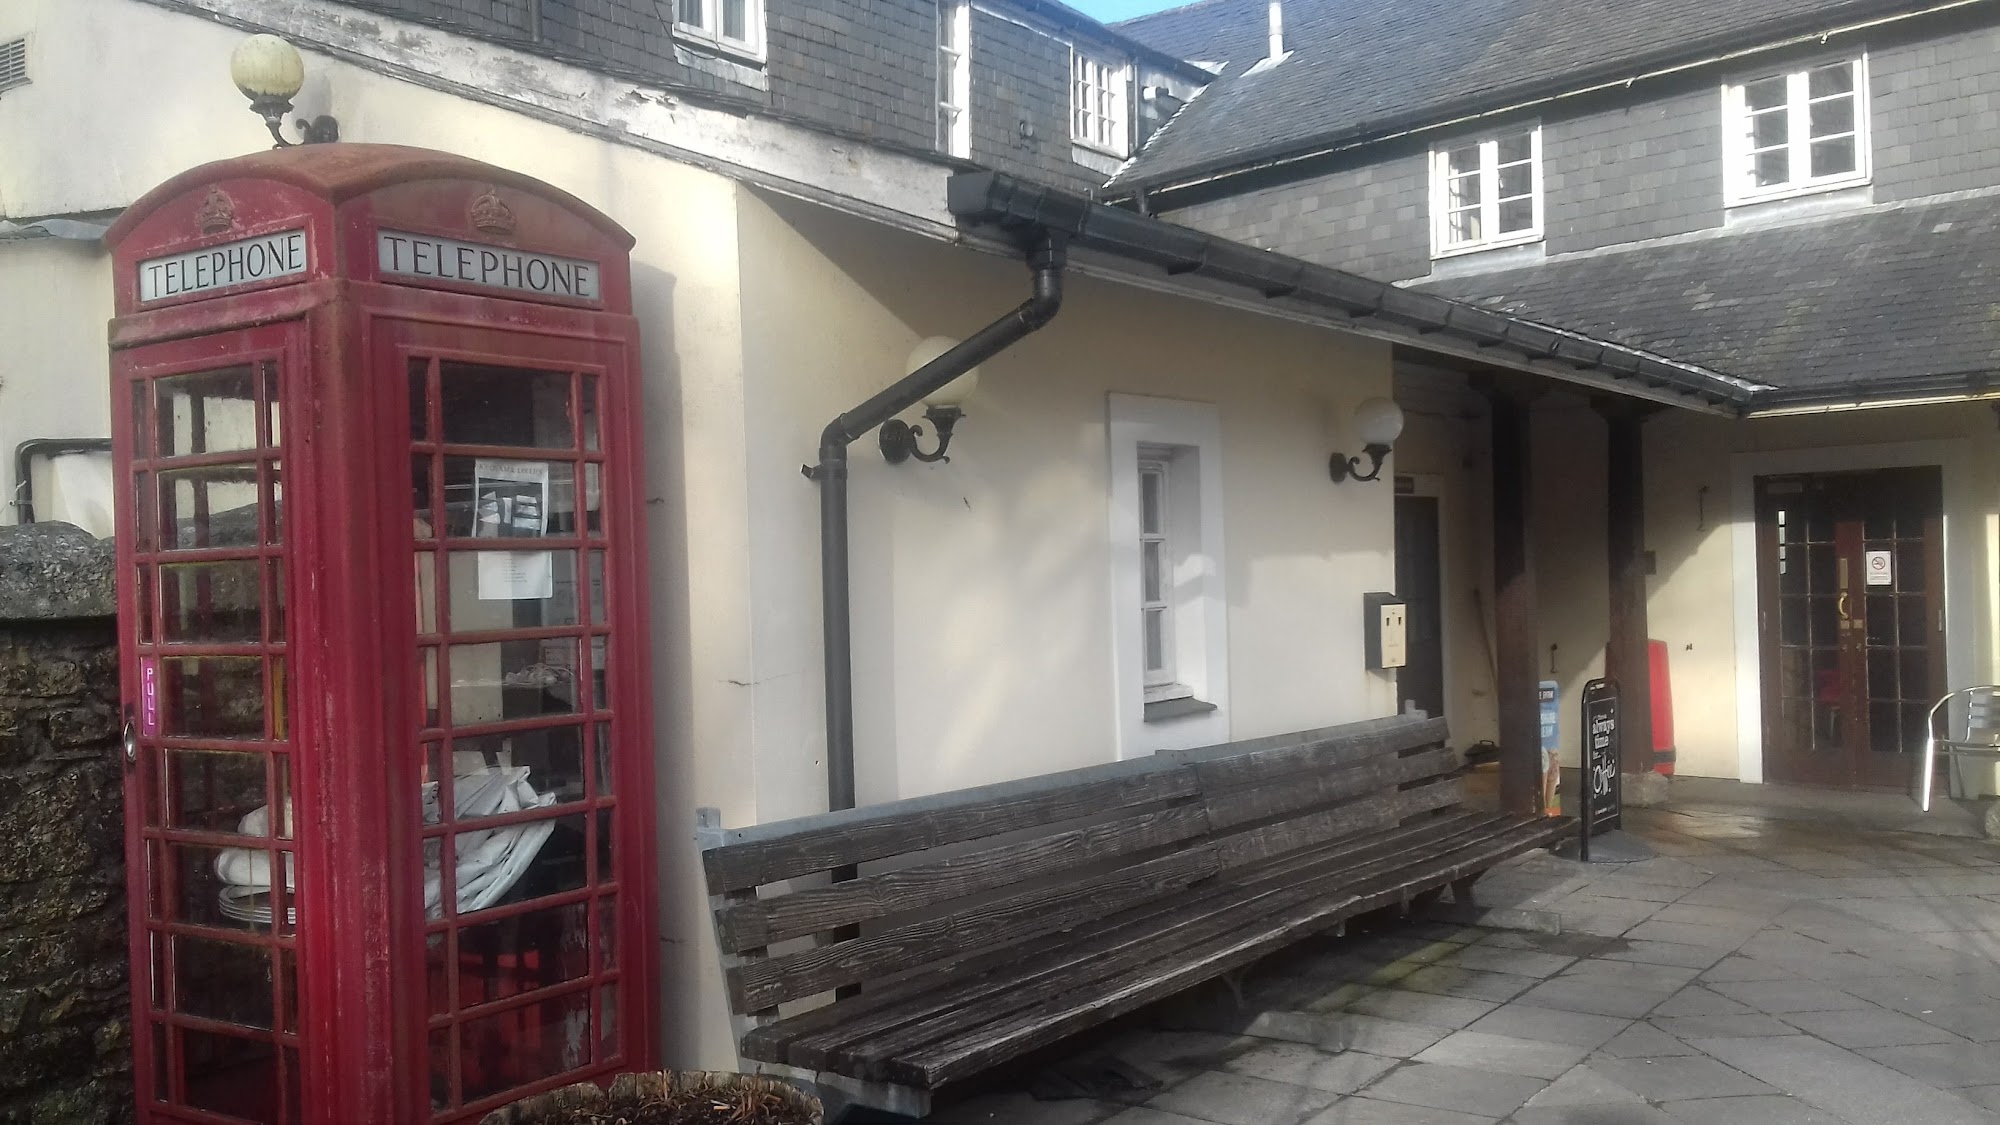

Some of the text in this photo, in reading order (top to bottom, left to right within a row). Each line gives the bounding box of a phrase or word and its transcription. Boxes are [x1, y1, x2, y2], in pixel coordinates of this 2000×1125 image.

[148, 234, 303, 298] TELEPHONE
[383, 236, 590, 297] TELEPHONE
[147, 667, 155, 726] PULL
[1594, 734, 1609, 749] time
